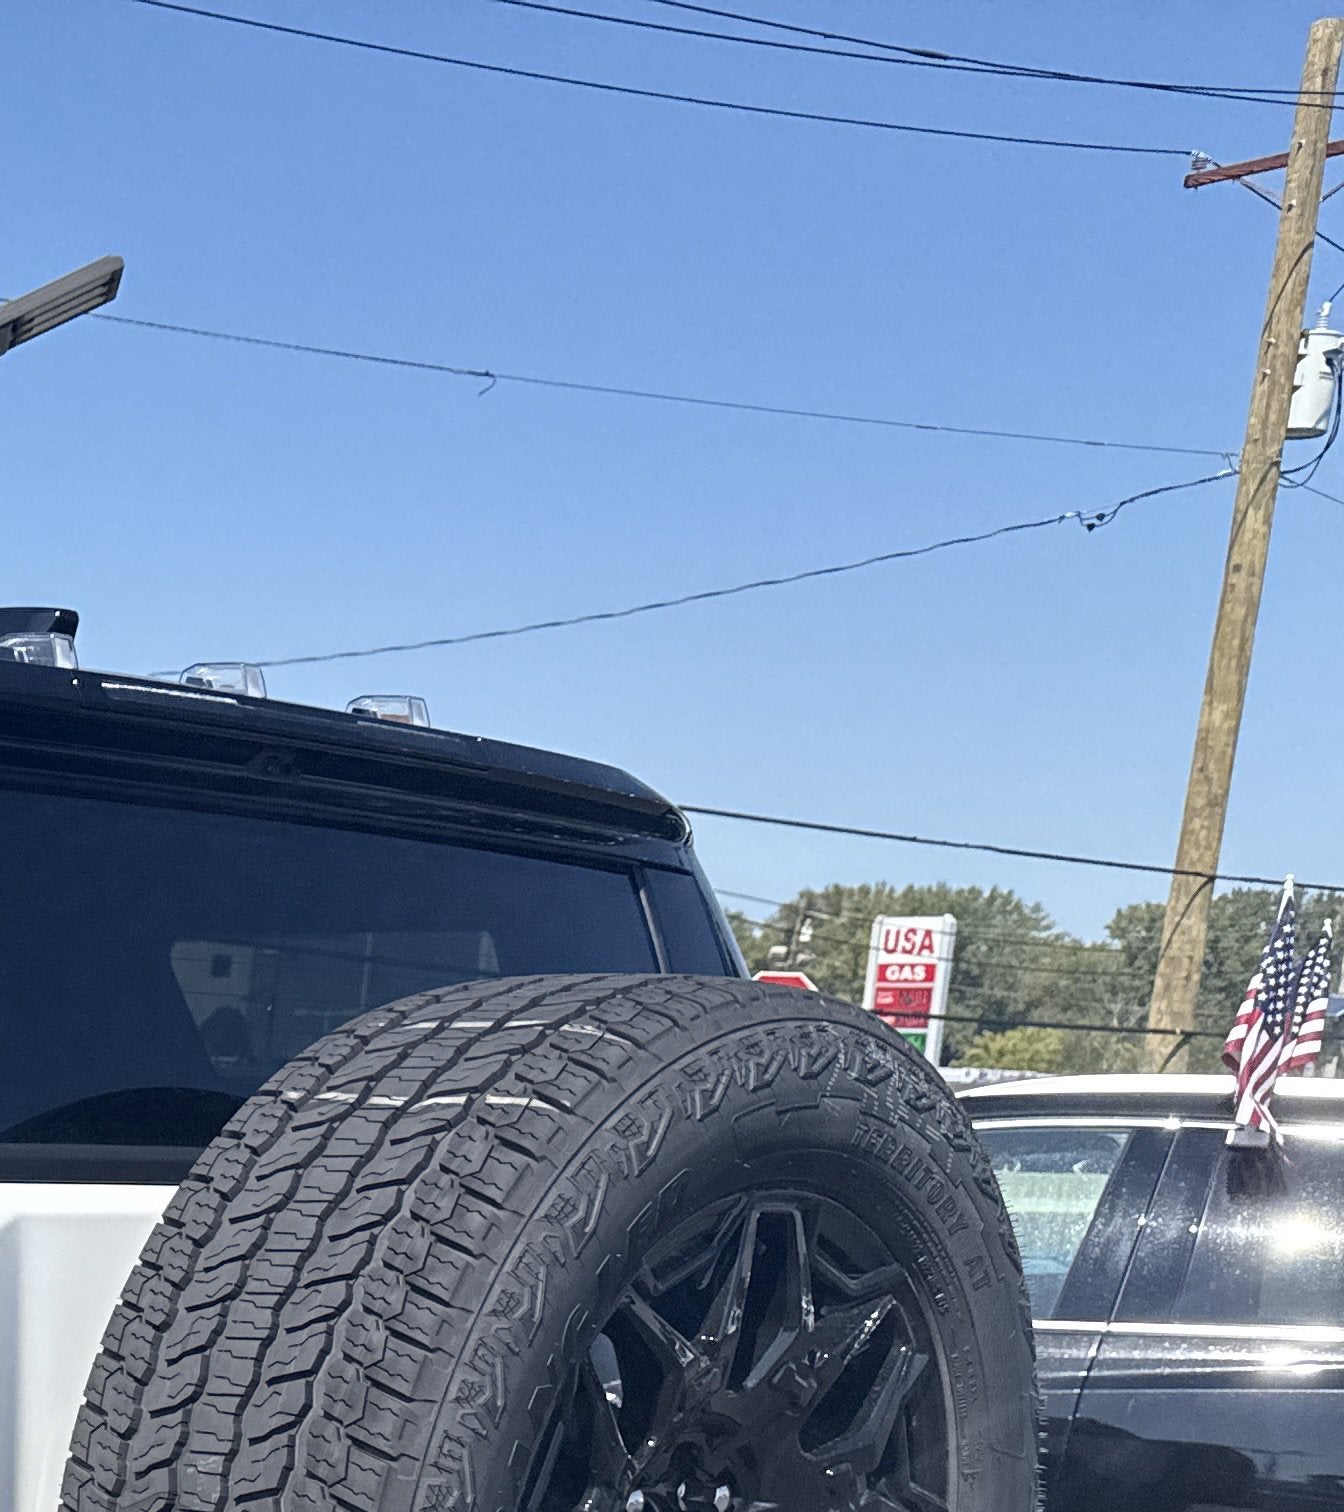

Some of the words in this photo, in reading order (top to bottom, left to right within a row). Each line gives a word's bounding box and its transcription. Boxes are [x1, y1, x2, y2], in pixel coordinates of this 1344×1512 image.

[883, 927, 935, 955] USA
[885, 965, 927, 981] GAS
[850, 1120, 968, 1236] TERRITORY
[963, 1255, 993, 1292] AT
